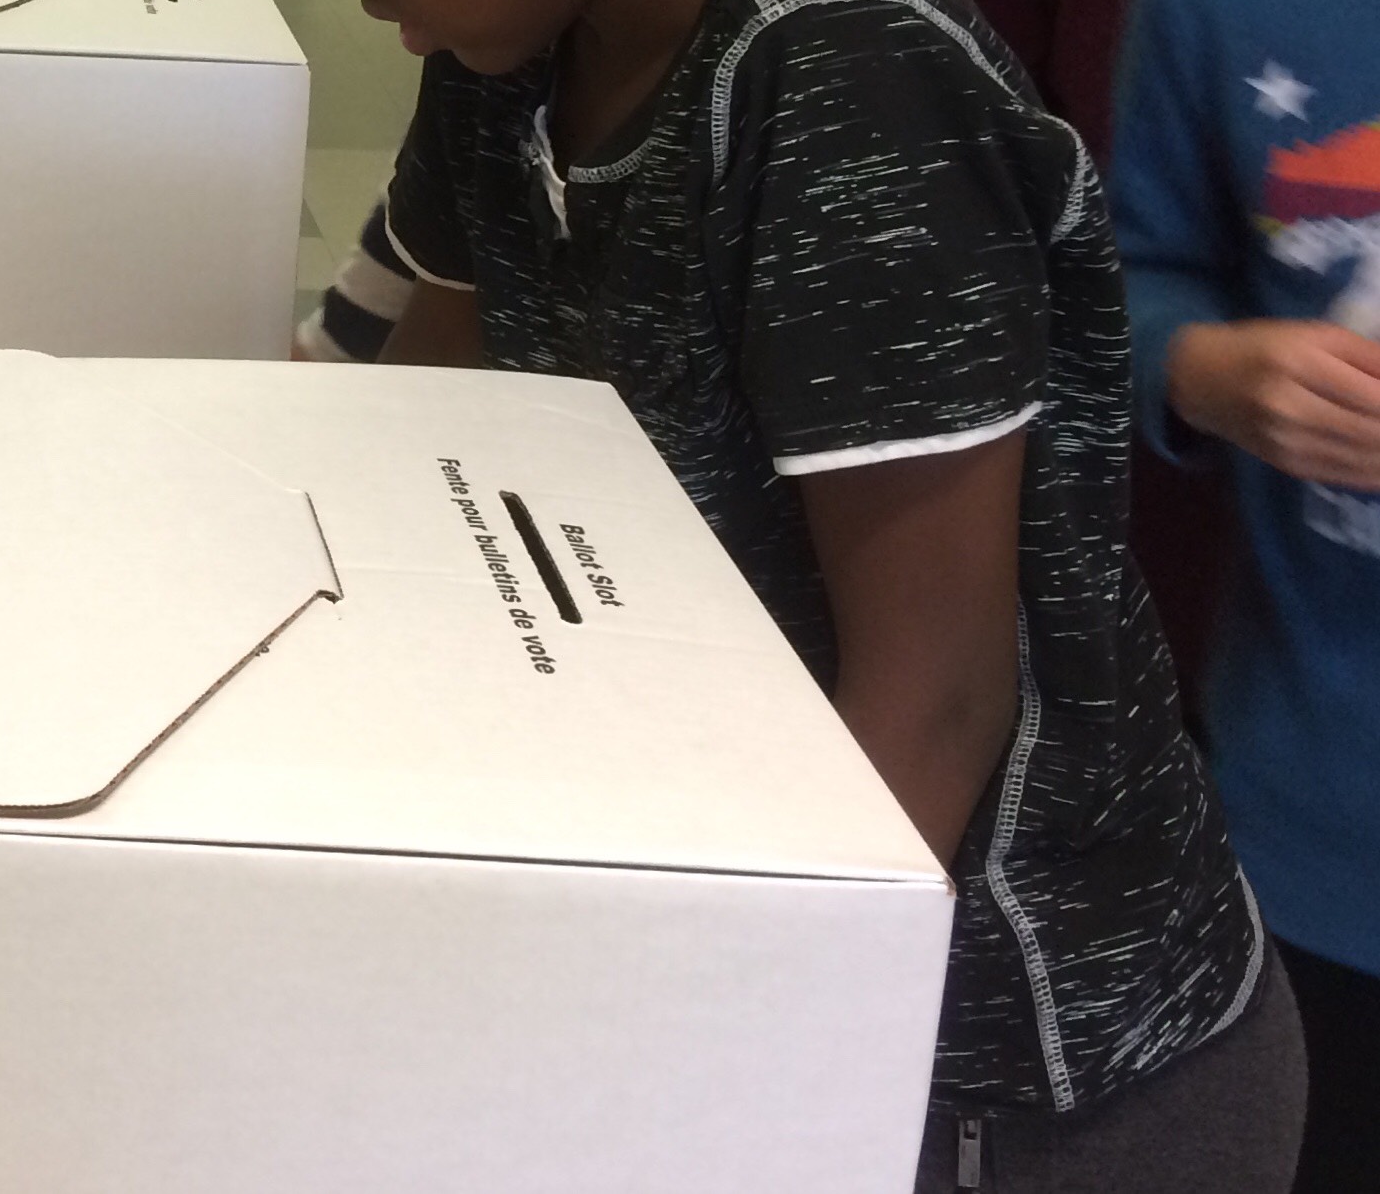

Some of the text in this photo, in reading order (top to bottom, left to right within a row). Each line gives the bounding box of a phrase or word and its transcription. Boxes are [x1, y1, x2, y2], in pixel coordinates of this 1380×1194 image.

[437, 458, 557, 675] Fente pour bulletins de vote
[559, 523, 625, 607] Ballot Slot
